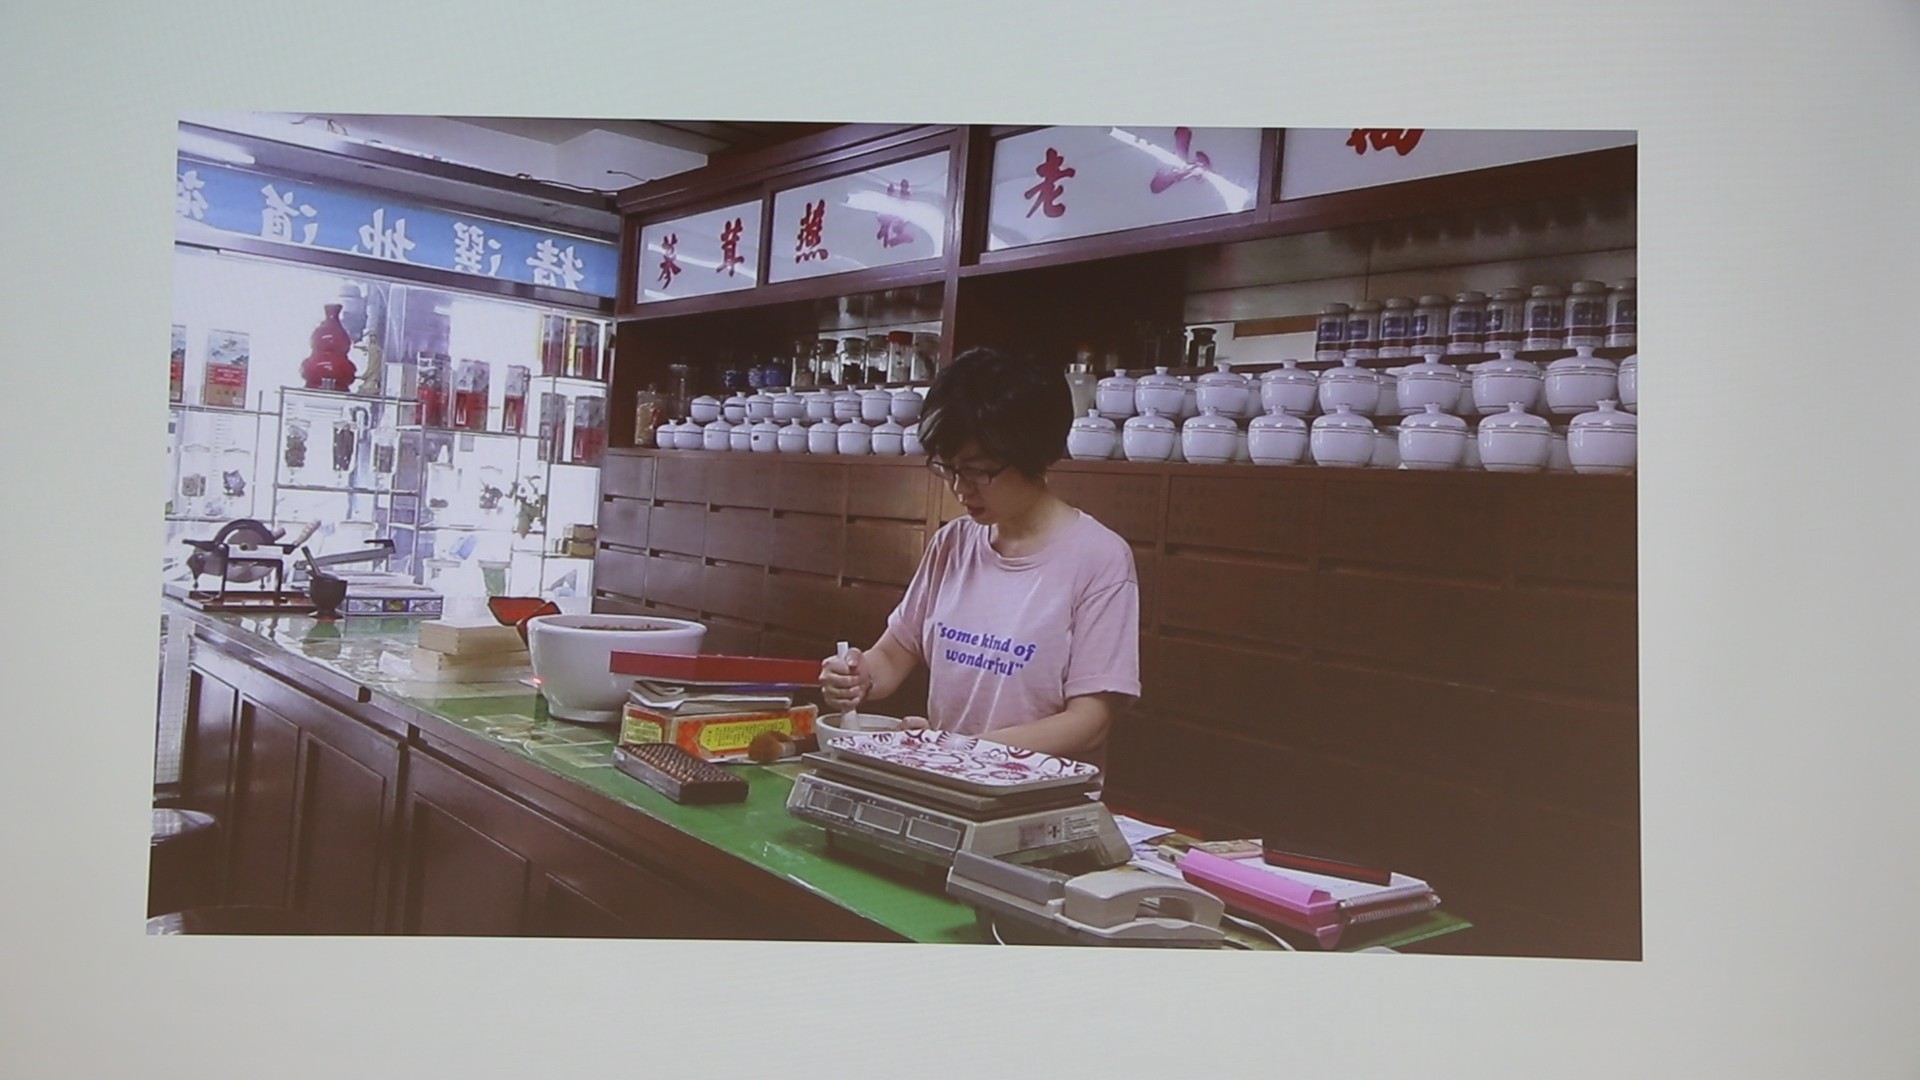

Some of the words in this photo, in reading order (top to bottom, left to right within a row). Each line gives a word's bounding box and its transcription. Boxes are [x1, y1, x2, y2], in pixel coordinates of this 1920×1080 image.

[937, 622, 980, 646] "some
[980, 633, 1012, 653] kind
[1013, 644, 1036, 661] of
[946, 648, 1024, 676] wonderful"
